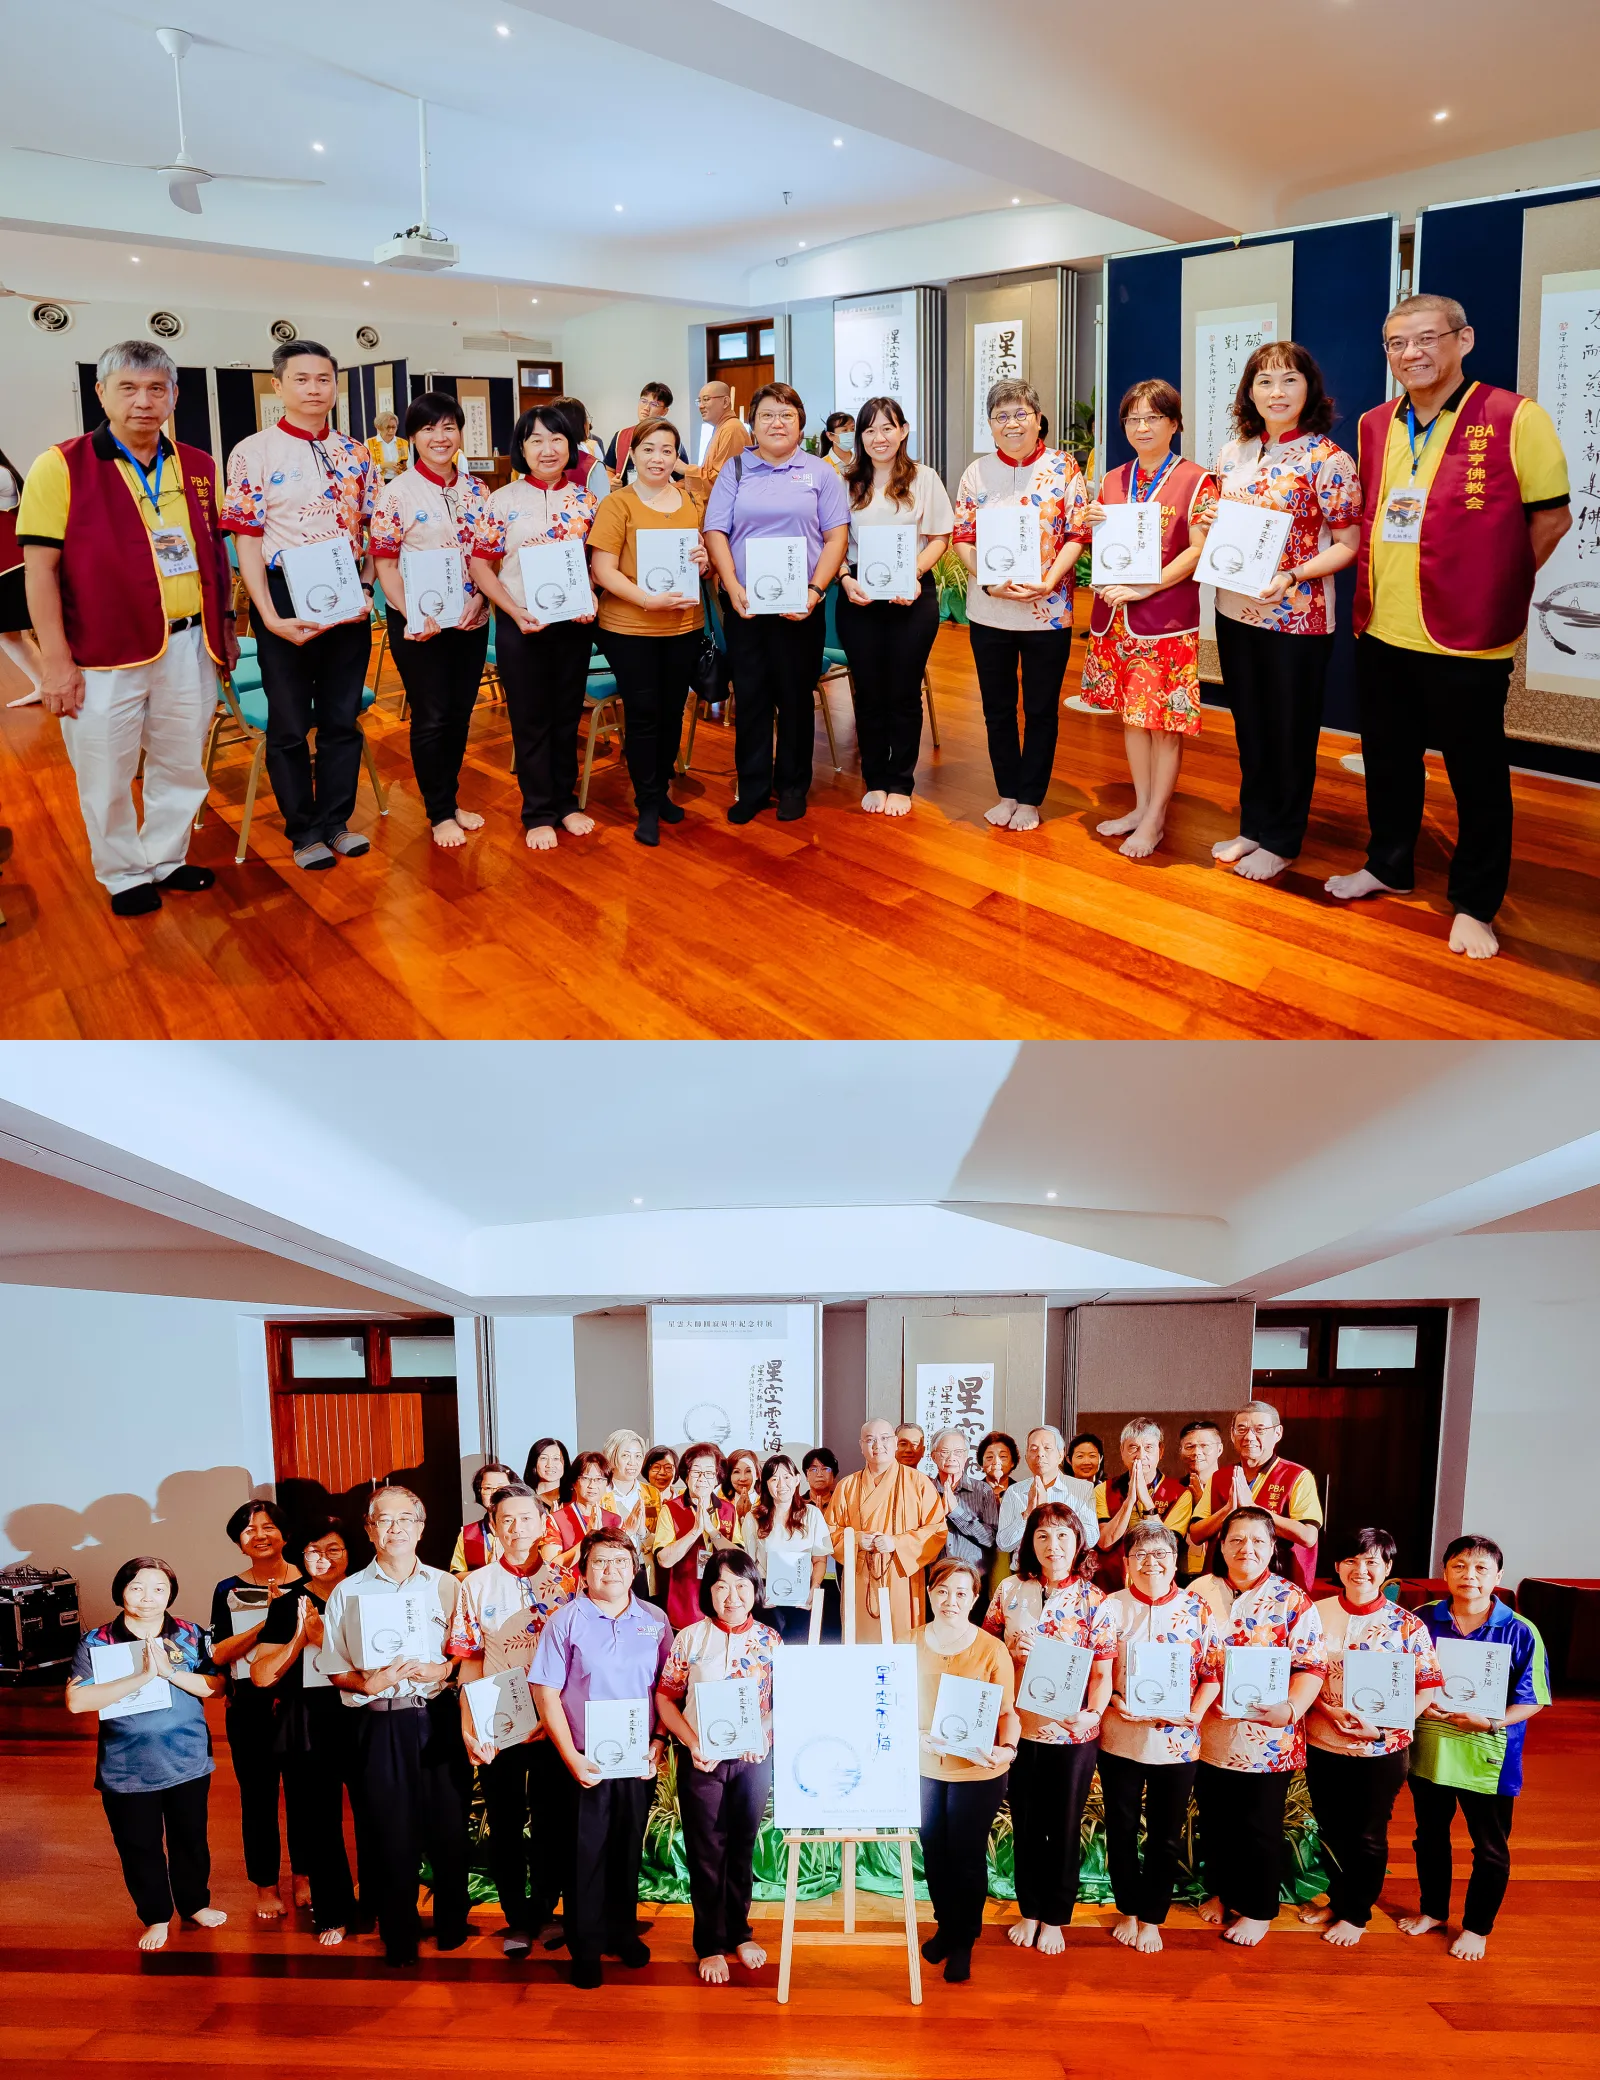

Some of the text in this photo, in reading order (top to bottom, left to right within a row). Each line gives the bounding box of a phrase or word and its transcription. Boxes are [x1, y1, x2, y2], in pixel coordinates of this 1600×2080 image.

[889, 329, 900, 391] 星空雲海
[1465, 424, 1495, 438] PBA
[1464, 438, 1488, 510] 彭亨佛教会
[190, 476, 211, 487] PBA
[1162, 506, 1176, 516] BA
[763, 1360, 783, 1453] 星空雲海
[1268, 1484, 1285, 1493] PBA
